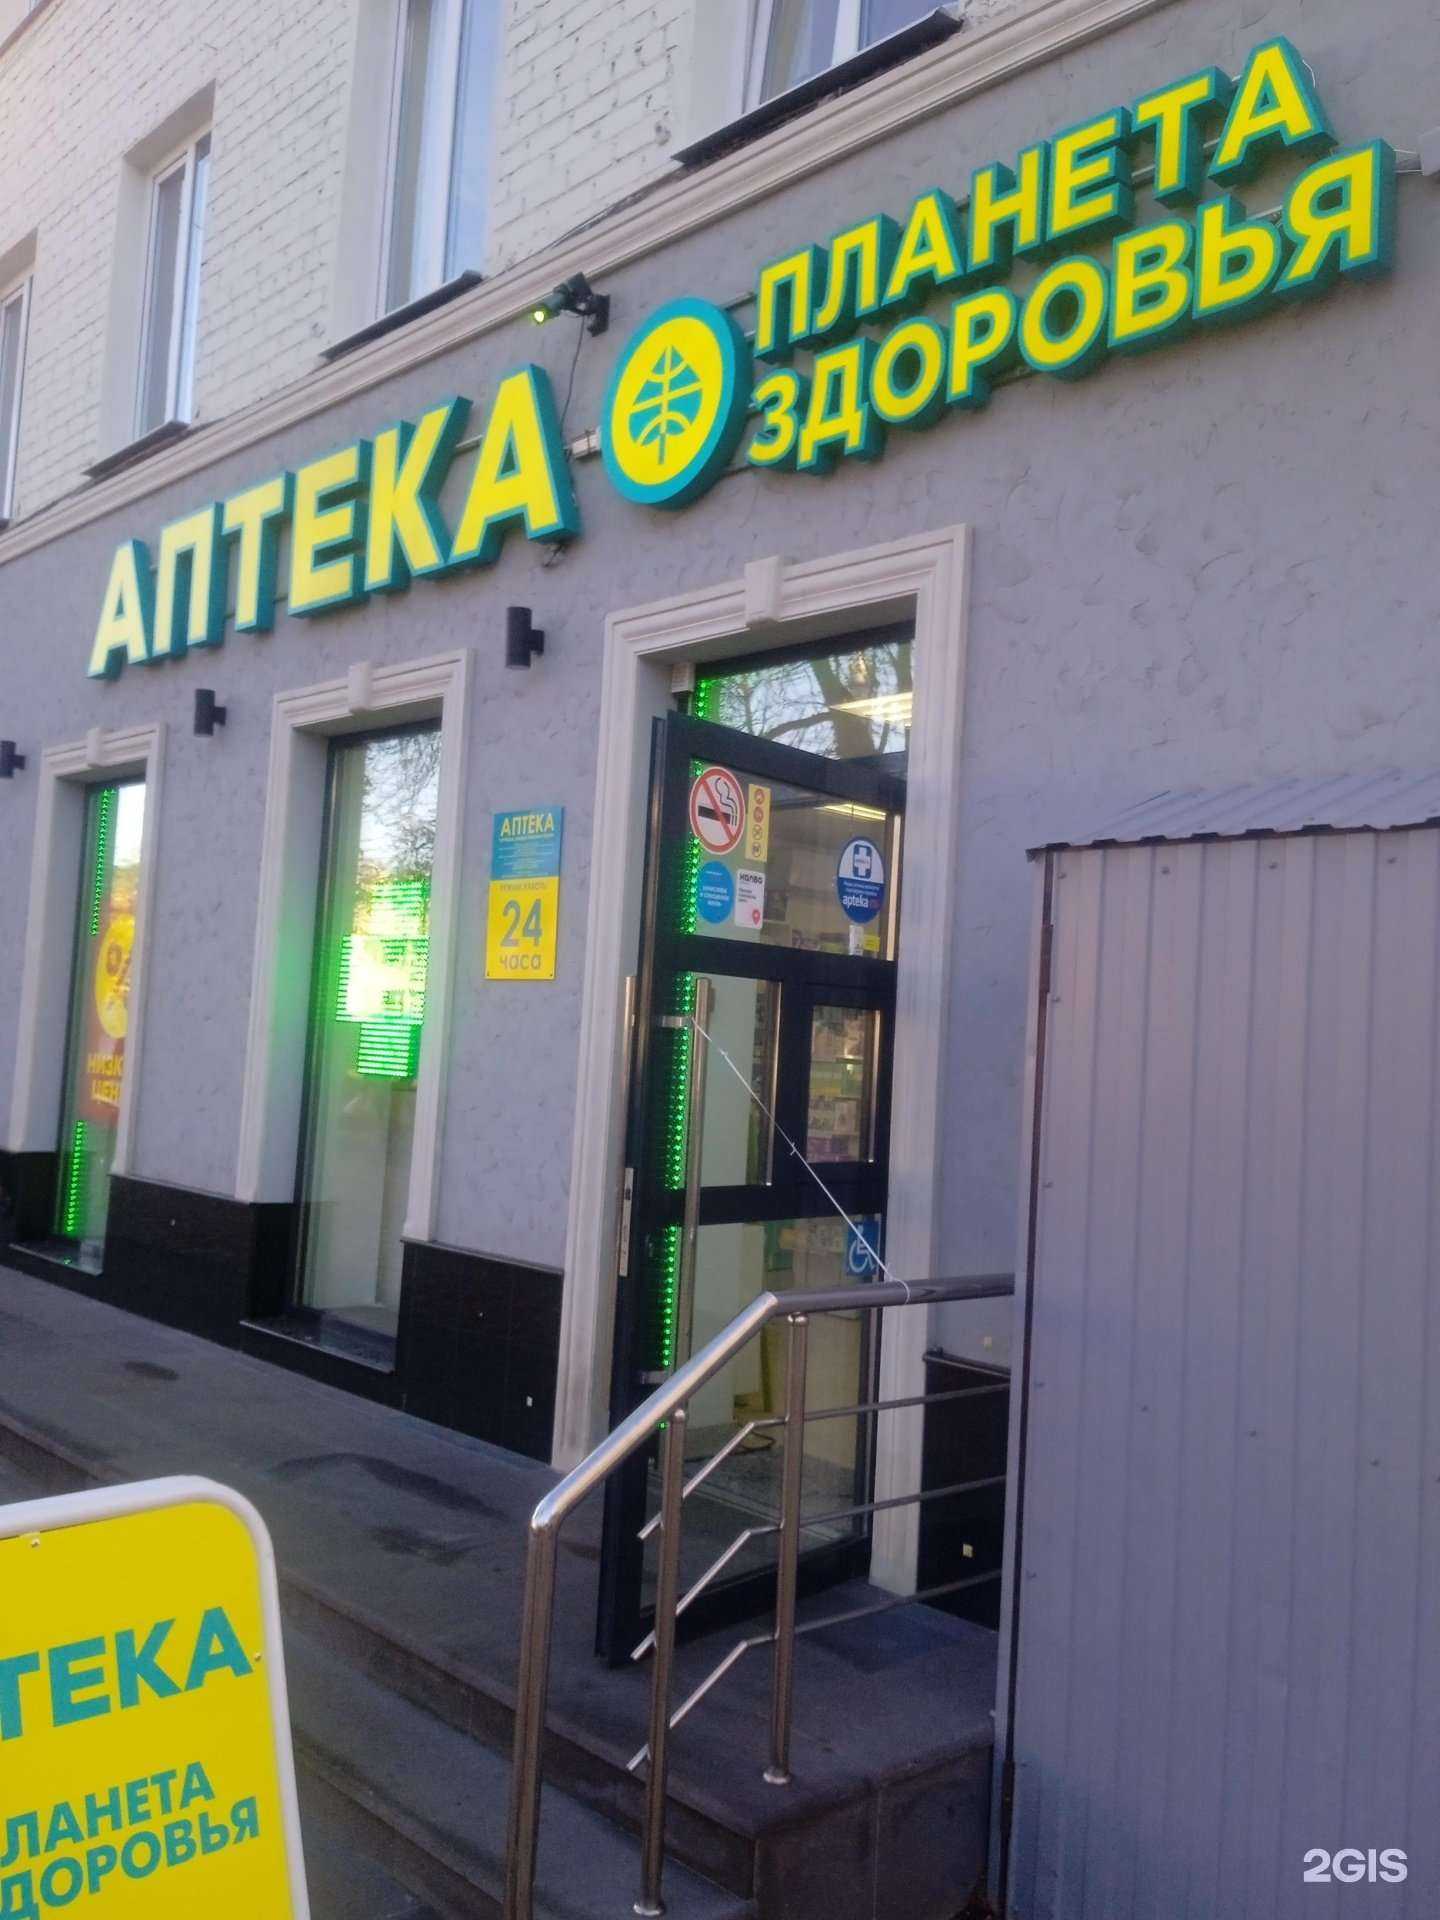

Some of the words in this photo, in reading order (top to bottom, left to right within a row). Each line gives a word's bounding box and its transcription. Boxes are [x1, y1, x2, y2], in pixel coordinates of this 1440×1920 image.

[747, 138, 1394, 473] ЗДОРОВЬЯ
[755, 36, 1336, 361] ПЛАНЕТА
[87, 364, 578, 679] АПТЕКА
[500, 813, 554, 837] АПТЕКА
[500, 898, 543, 947] 24
